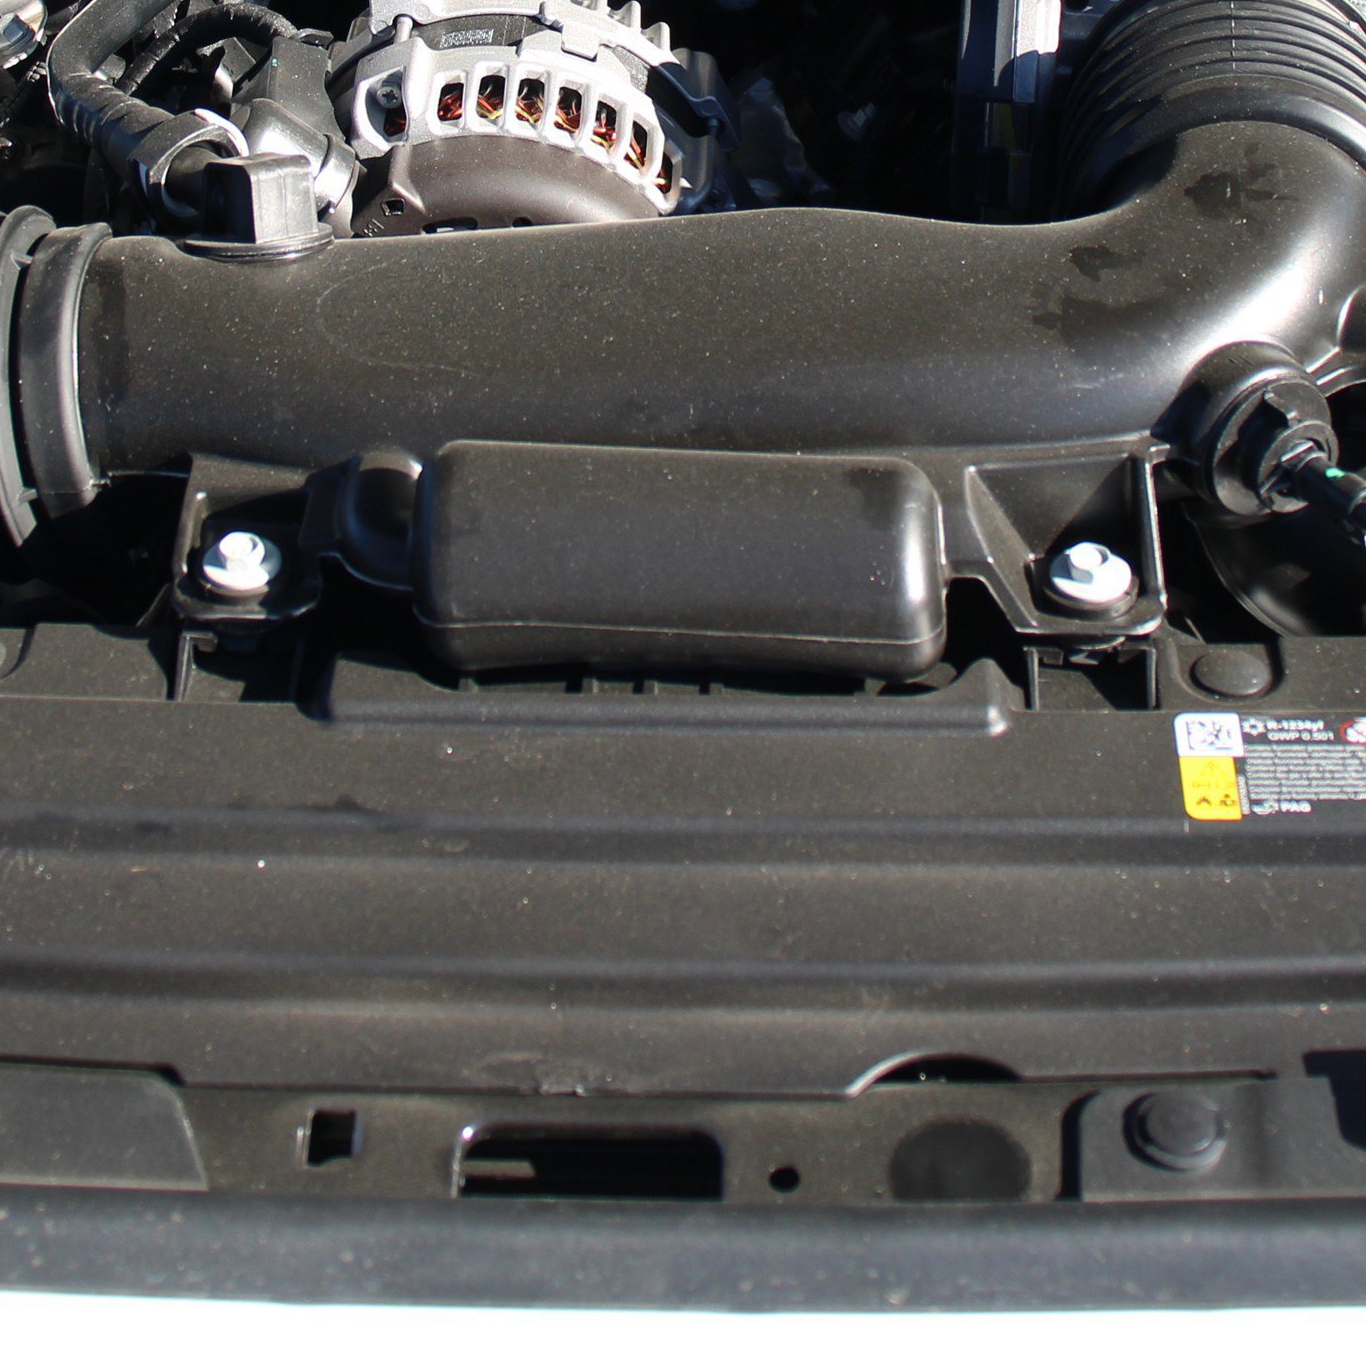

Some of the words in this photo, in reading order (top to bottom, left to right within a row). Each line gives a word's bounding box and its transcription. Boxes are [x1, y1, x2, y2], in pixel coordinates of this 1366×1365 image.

[1266, 718, 1325, 732] R-1234yf
[1267, 731, 1299, 741] GWP
[1301, 731, 1334, 741] 0.501
[1280, 801, 1312, 813] PAG
